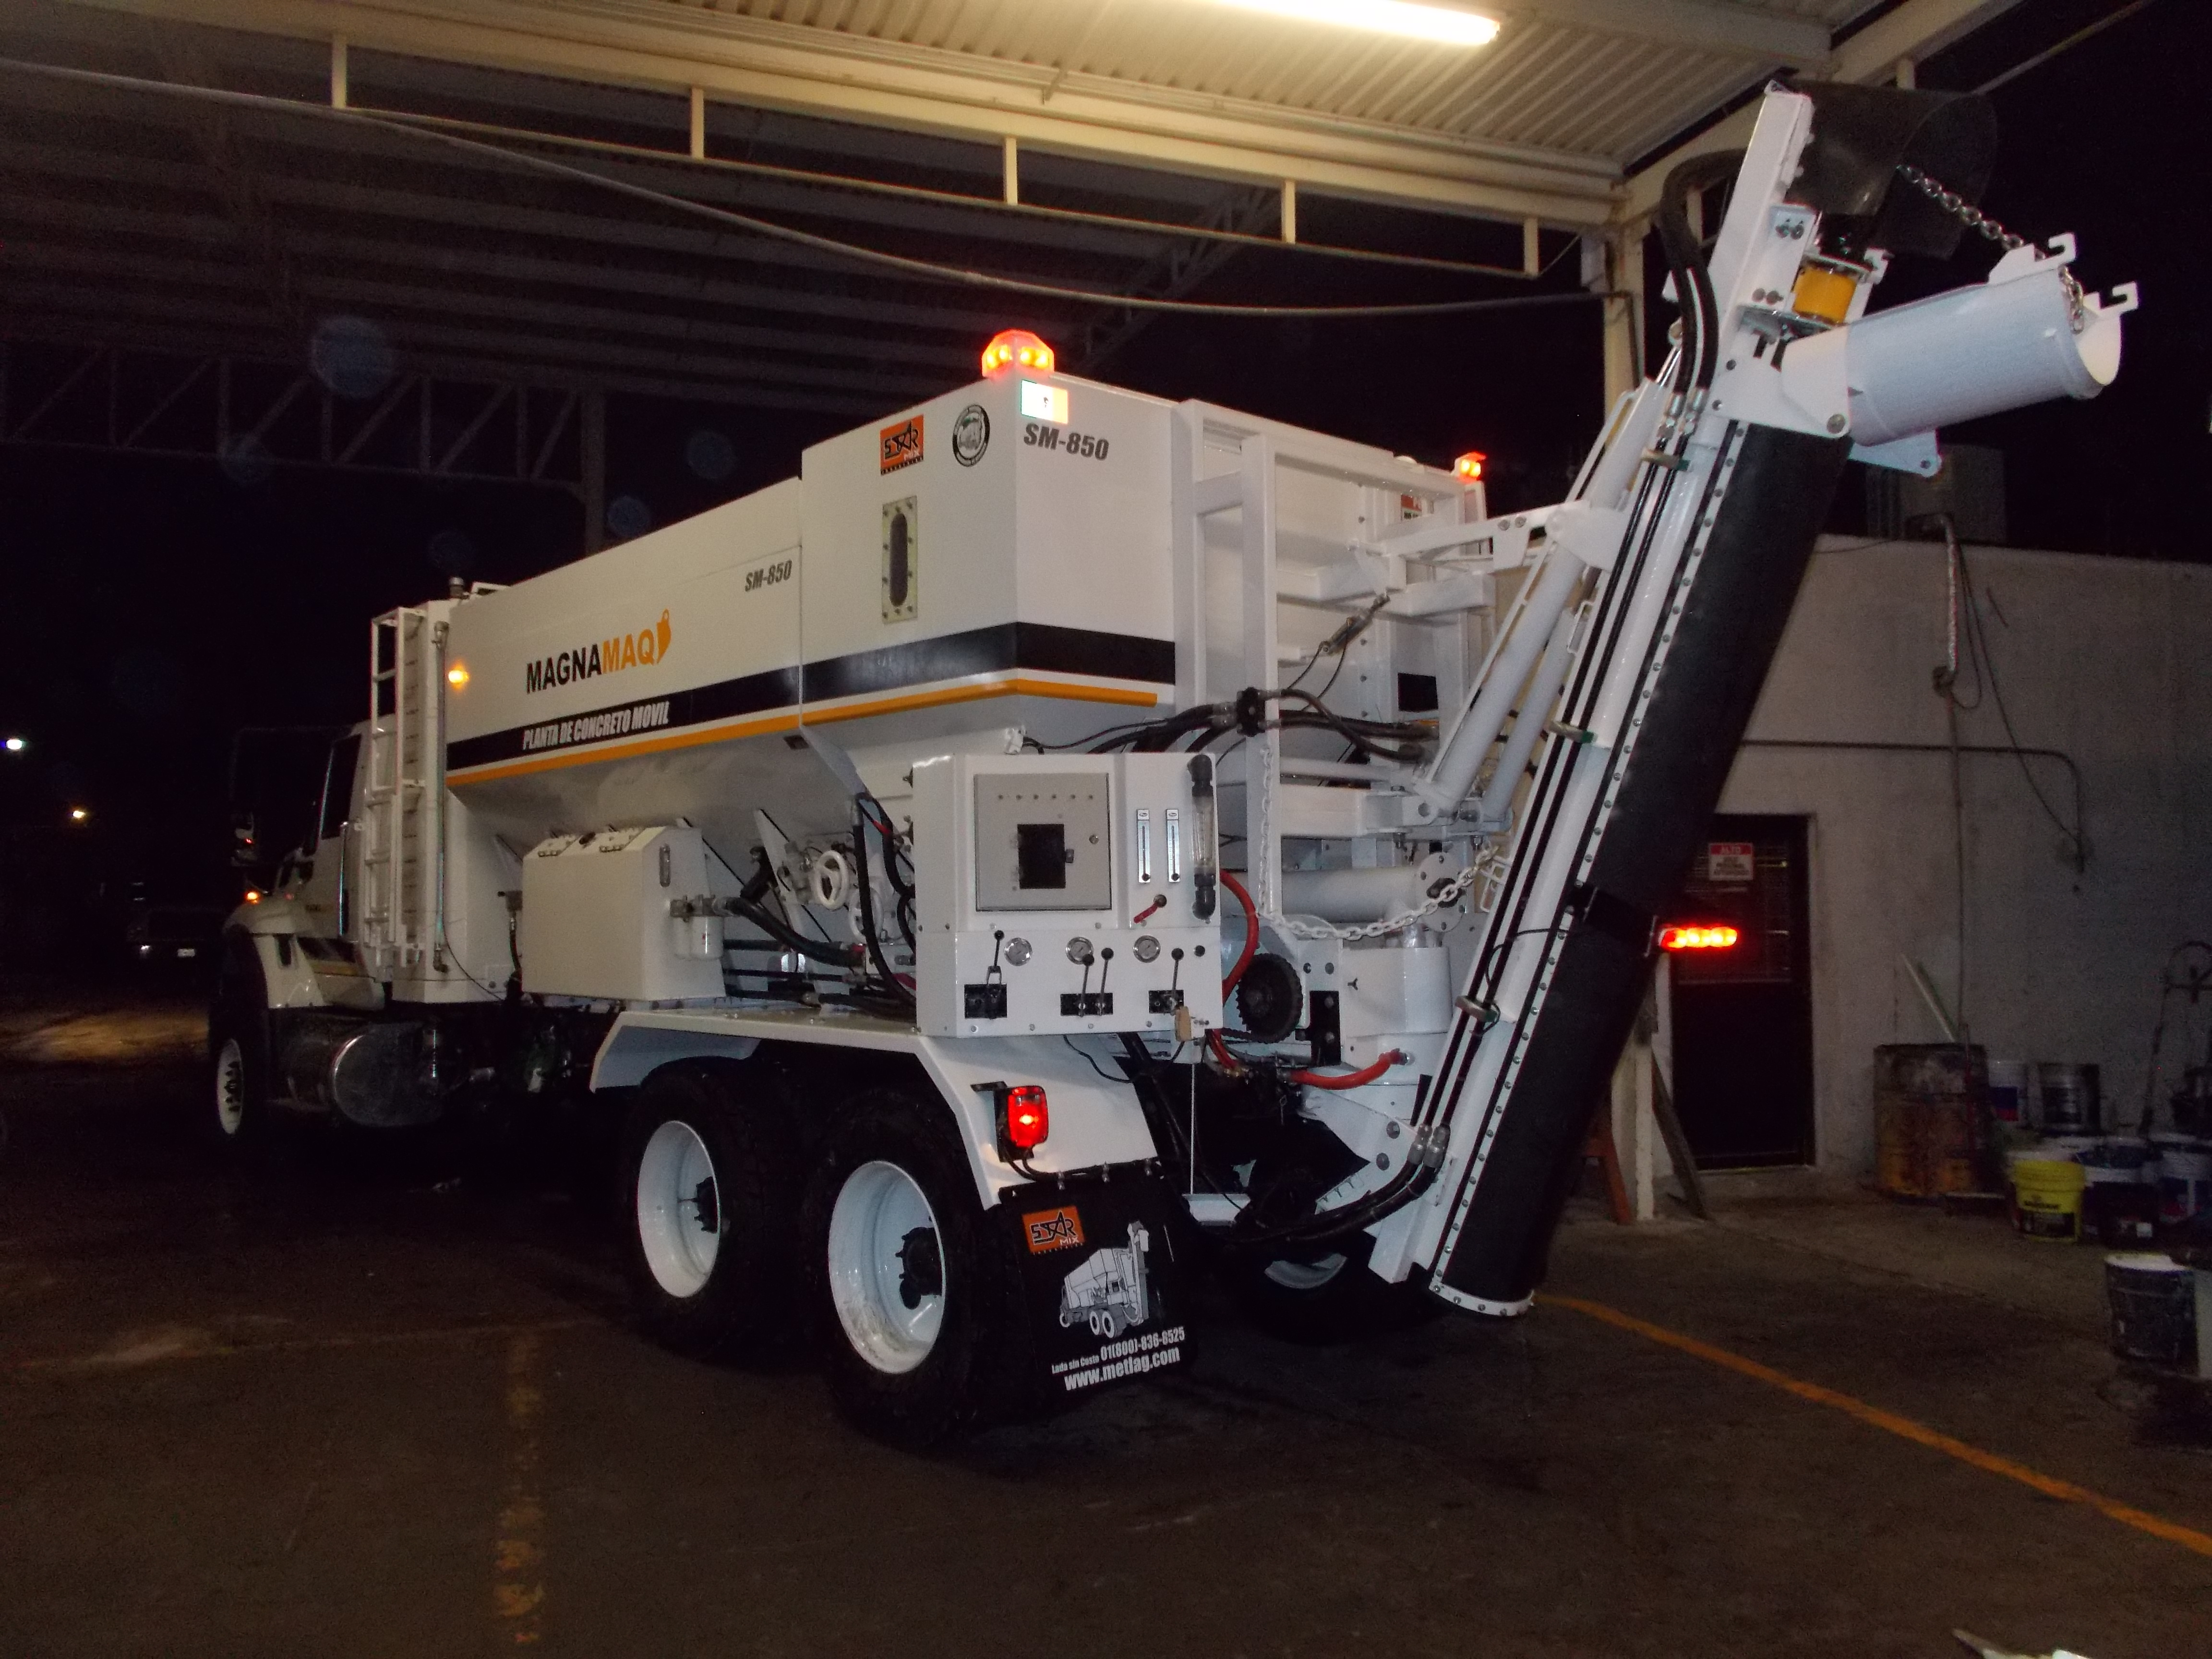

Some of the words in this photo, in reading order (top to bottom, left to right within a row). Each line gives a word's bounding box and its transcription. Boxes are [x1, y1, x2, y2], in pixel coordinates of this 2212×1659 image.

[1023, 423, 1109, 461] SM-850
[745, 559, 793, 592] SM-850
[526, 628, 655, 694] MAGNAMAQ
[522, 724, 559, 750] PLANTA
[559, 720, 574, 743] DE
[574, 709, 631, 741] CONCRETO
[631, 700, 670, 730] MOVIL
[1029, 1210, 1079, 1246] STAR
[1059, 1236, 1080, 1246] MIX
[1064, 1346, 1181, 1391] www.metlag.com
[1069, 1358, 1080, 1370] sin
[1080, 1354, 1100, 1367] Costo
